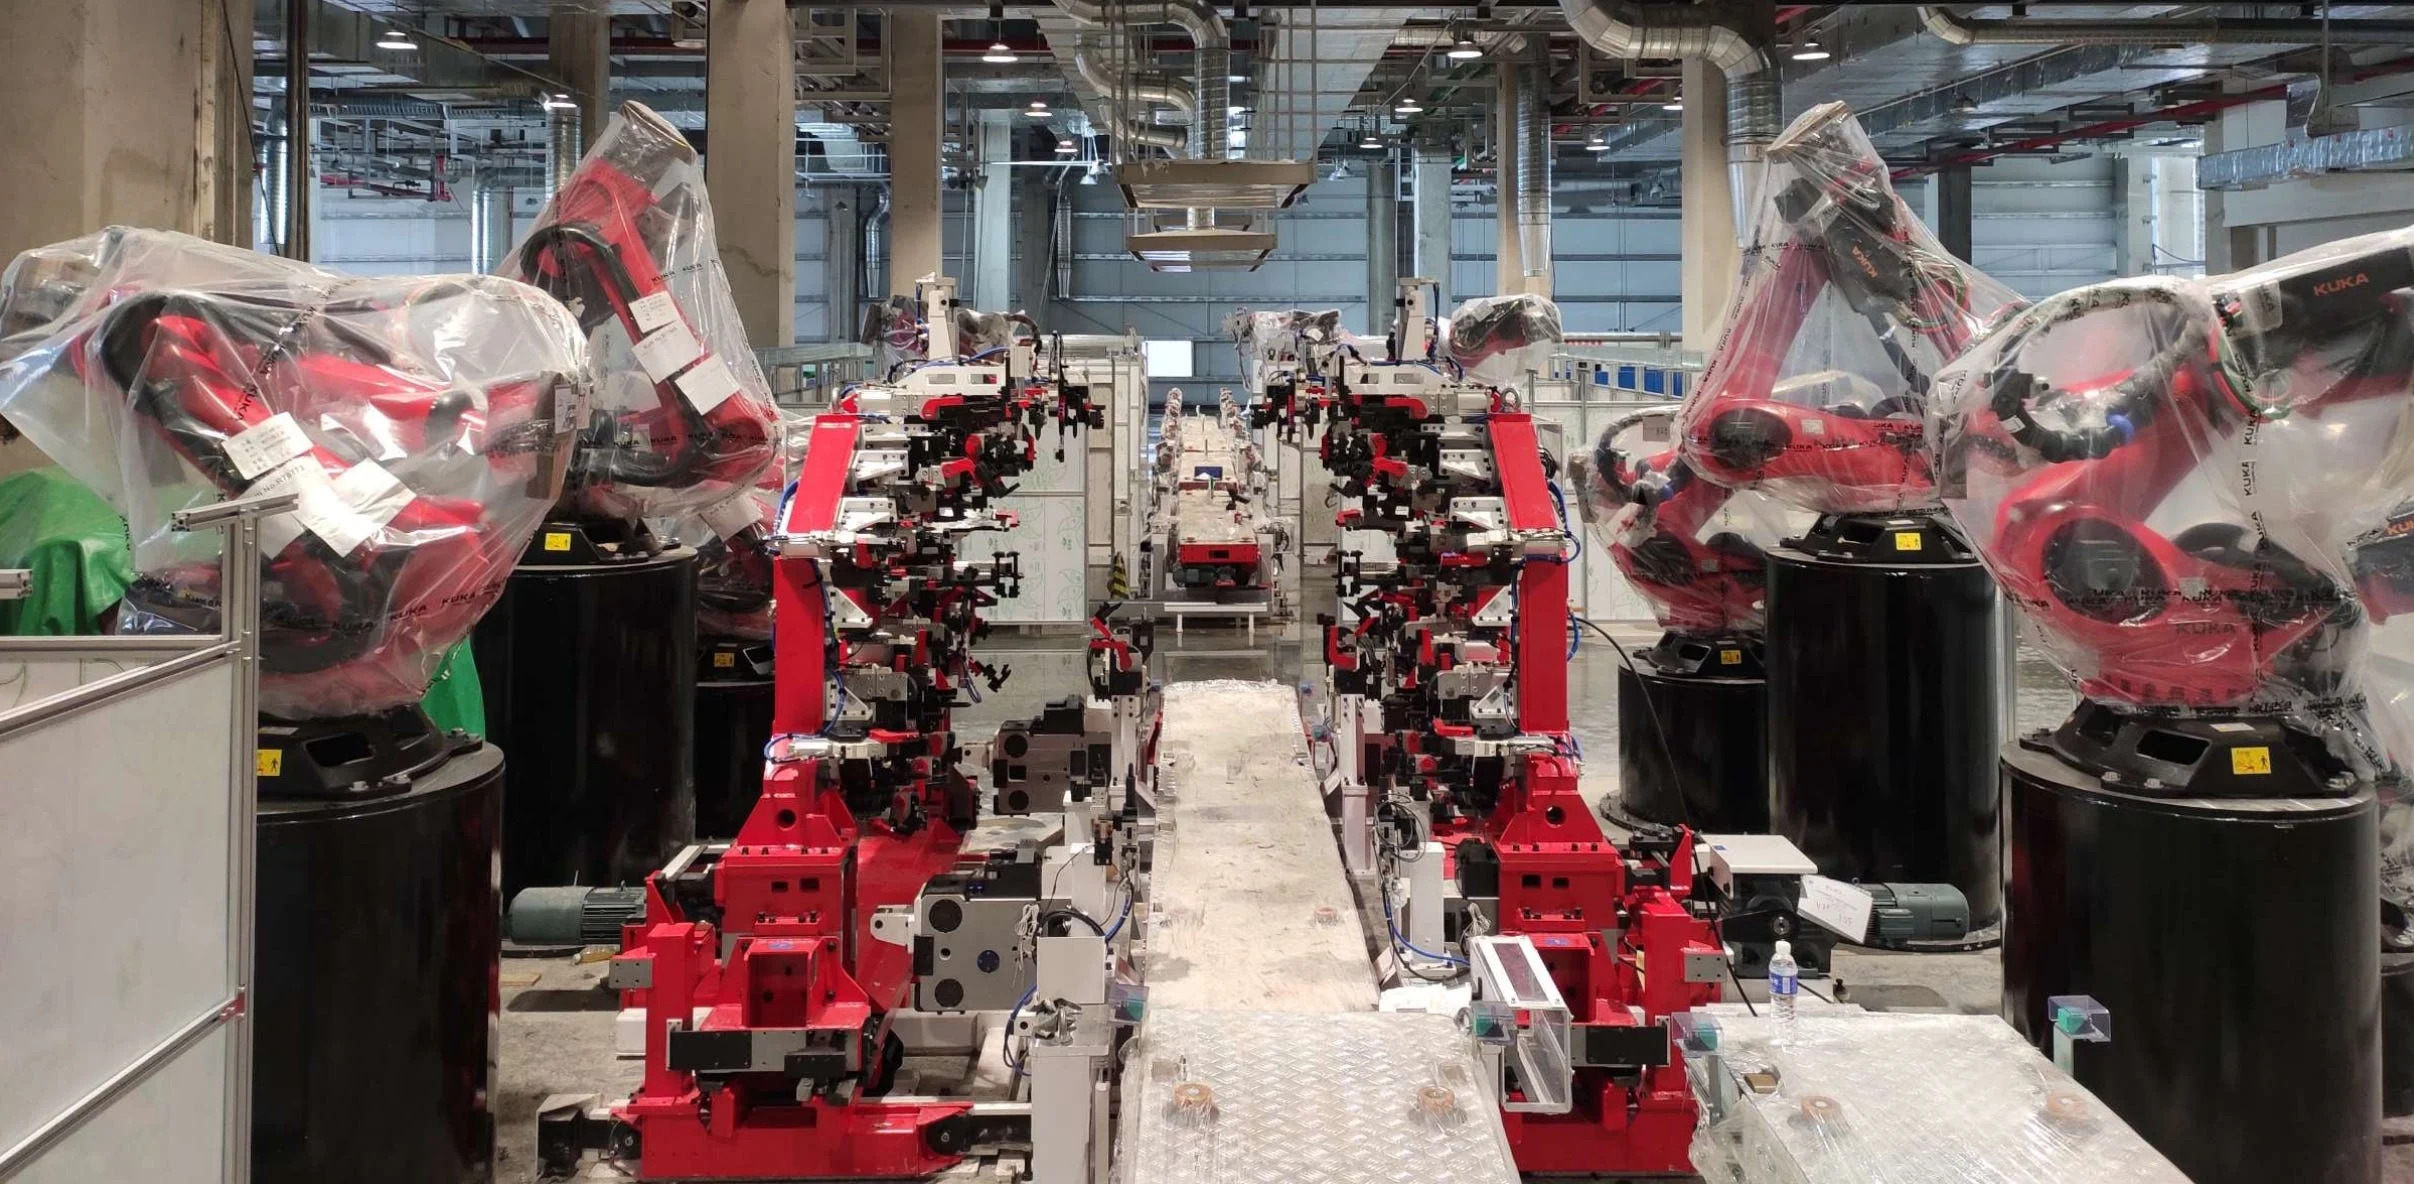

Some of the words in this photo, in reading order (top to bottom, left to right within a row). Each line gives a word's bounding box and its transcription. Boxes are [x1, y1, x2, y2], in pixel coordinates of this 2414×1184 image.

[1852, 246, 1880, 278] KUKA
[2313, 273, 2369, 296] KUKA
[236, 385, 259, 421] KUKA
[2243, 408, 2259, 446] KUKA
[2241, 461, 2251, 496] KUKA
[390, 604, 428, 621] KUKA
[441, 591, 476, 607] KUKA
[2176, 622, 2237, 635] KUKA
